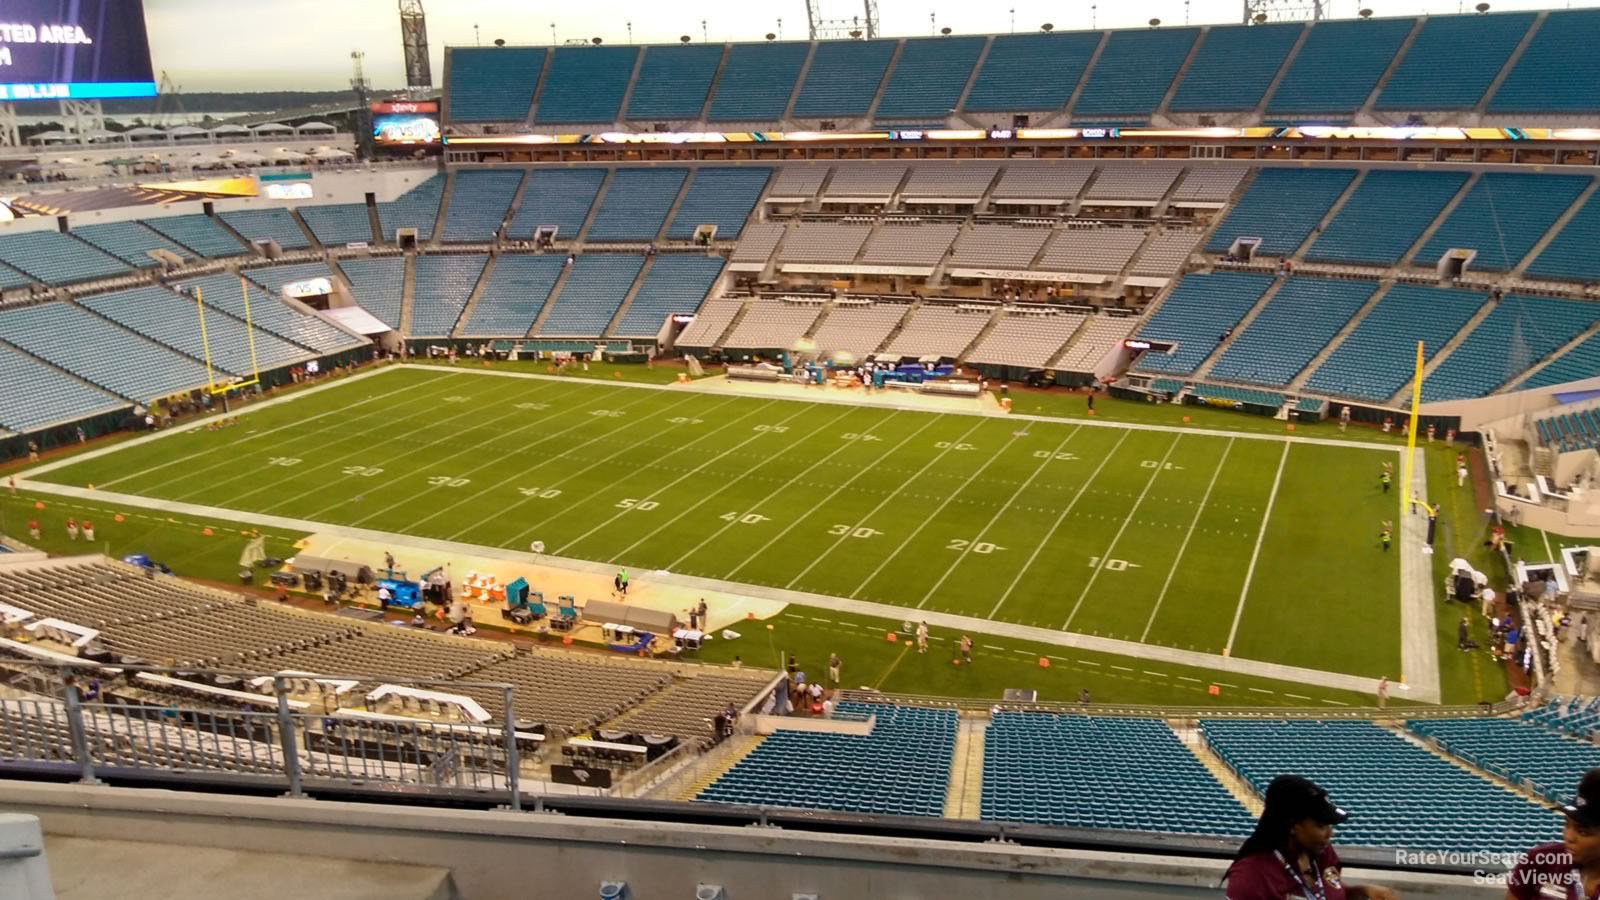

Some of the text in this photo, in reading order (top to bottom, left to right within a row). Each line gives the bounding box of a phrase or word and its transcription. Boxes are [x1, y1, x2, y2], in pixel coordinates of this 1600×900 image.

[0, 23, 92, 44] TED AREA.
[1033, 450, 1073, 460] 20
[342, 466, 384, 476] 20
[428, 476, 471, 487] 30
[519, 488, 562, 499] 40
[615, 498, 660, 511] 50
[719, 511, 764, 524] 40
[828, 524, 877, 538] 30
[945, 539, 998, 554] 20
[1088, 556, 1130, 571] 10
